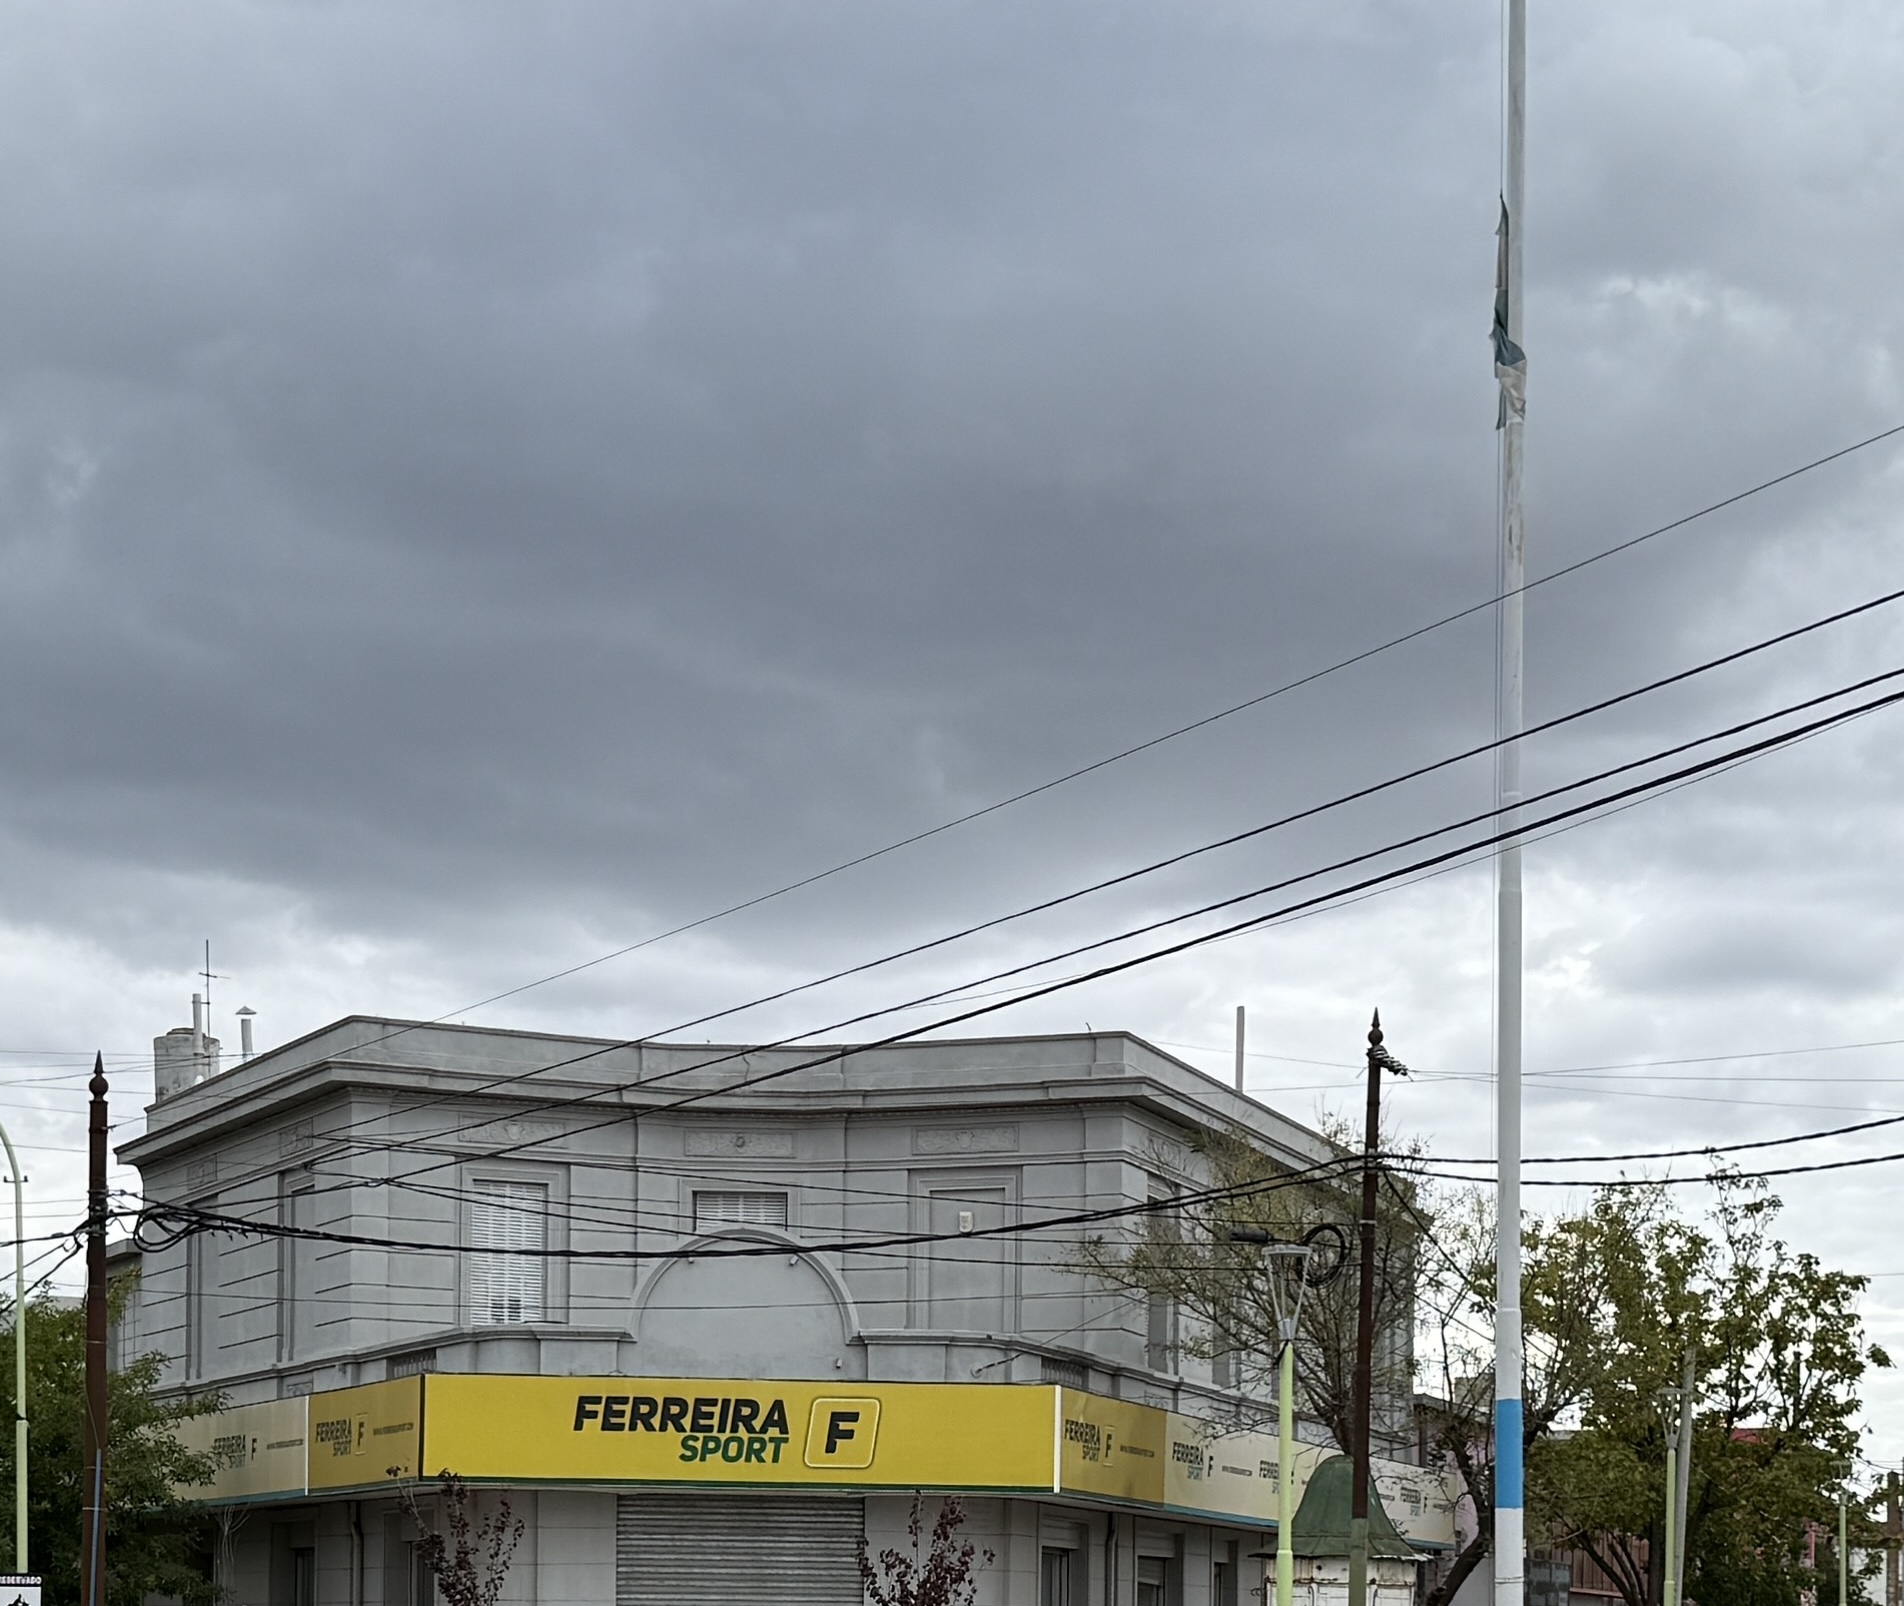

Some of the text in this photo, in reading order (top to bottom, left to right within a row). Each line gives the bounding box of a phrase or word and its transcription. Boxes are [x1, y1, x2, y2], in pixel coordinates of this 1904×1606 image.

[573, 1395, 790, 1435] FERREIRA
[316, 1418, 352, 1443] FERREIRA
[824, 1411, 860, 1454] F
[1065, 1419, 1100, 1446] FERREIRA
[678, 1434, 790, 1464] SPORT
